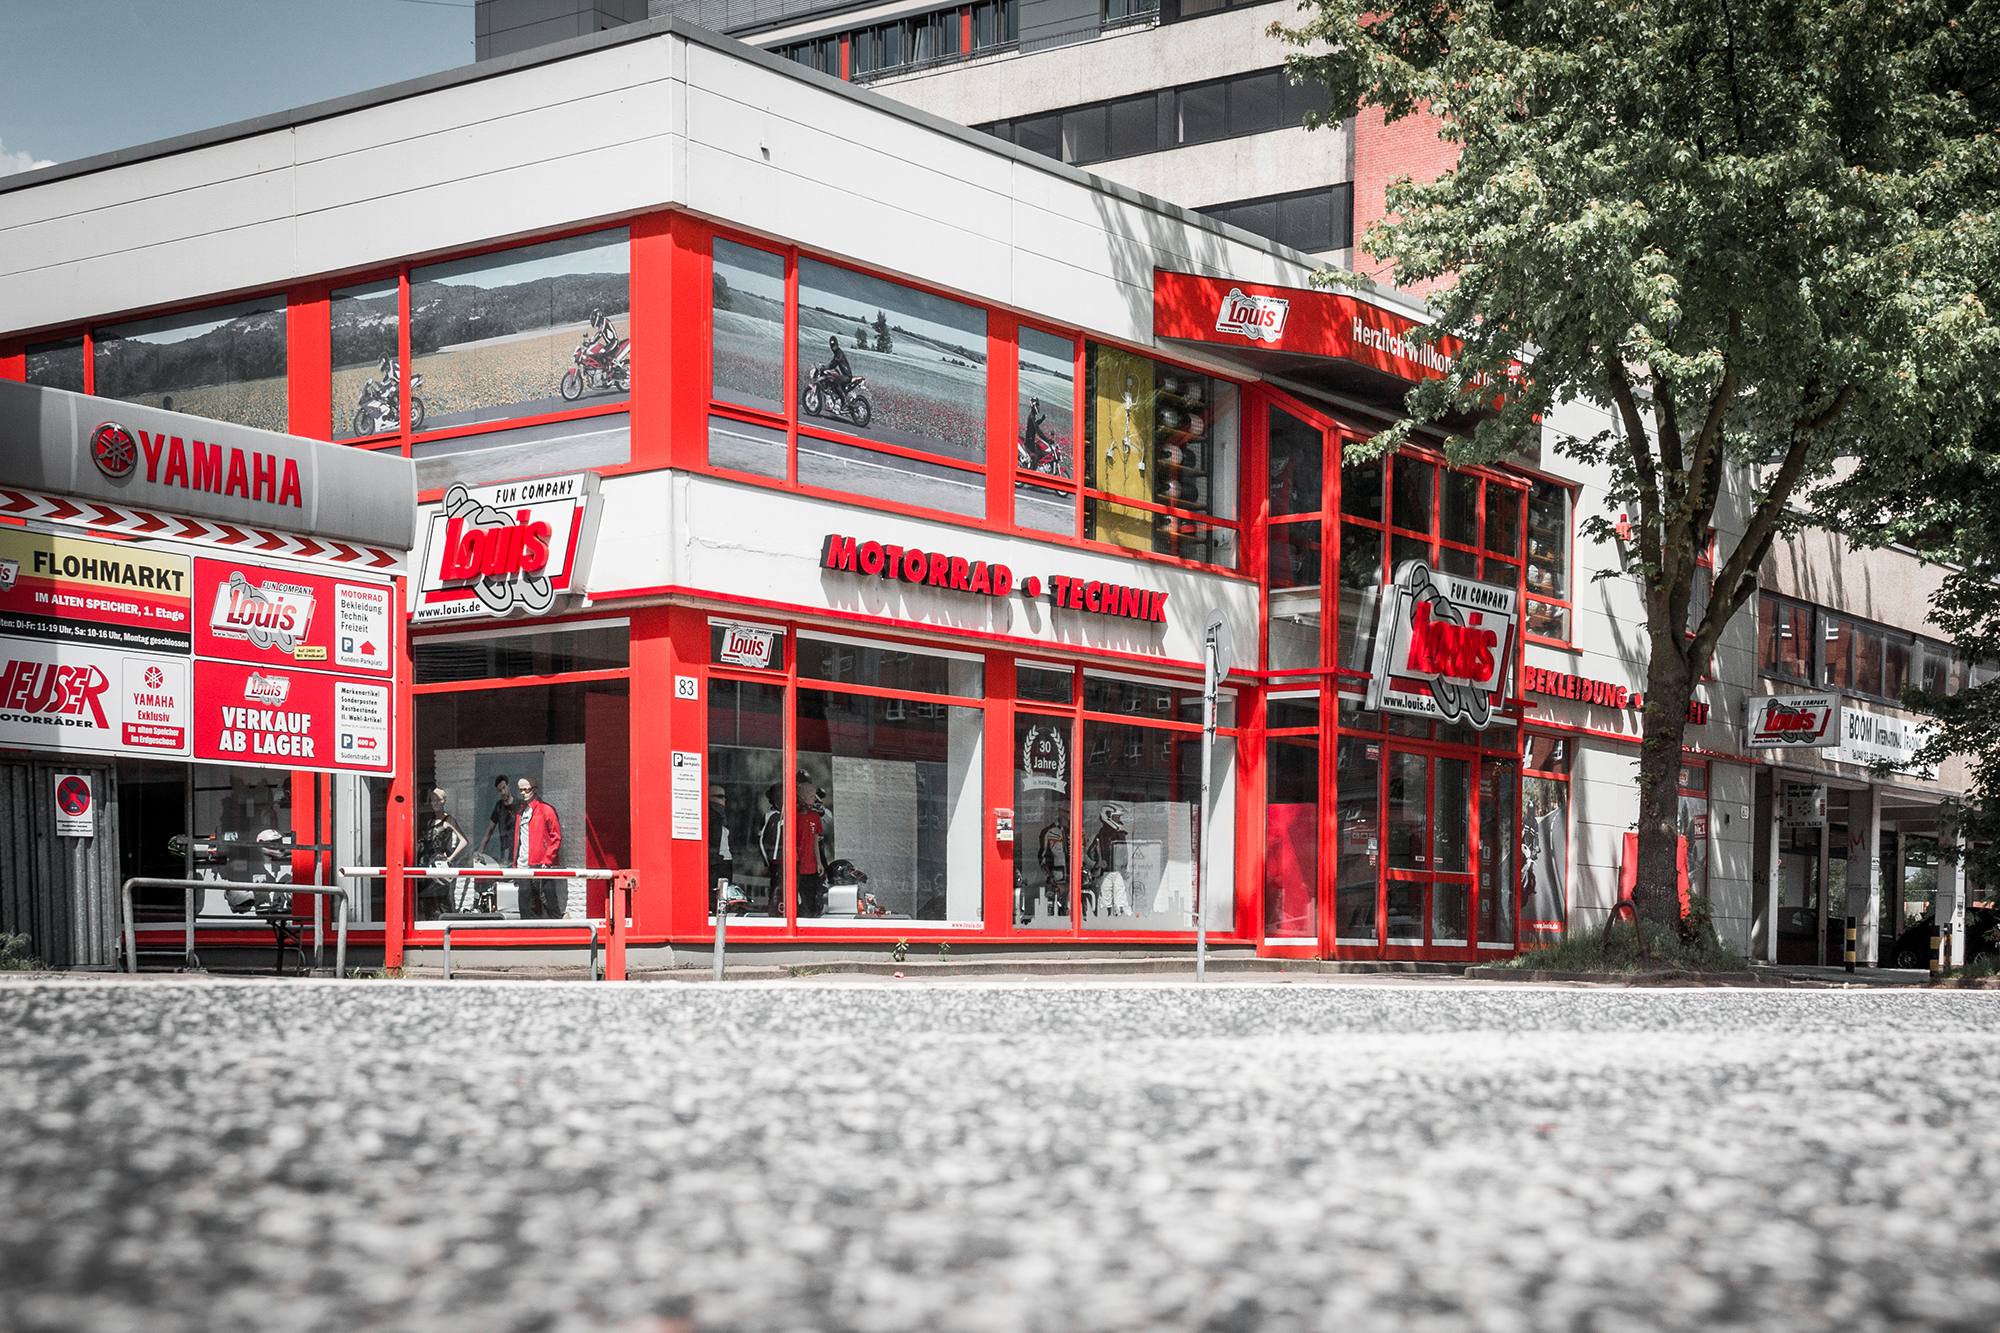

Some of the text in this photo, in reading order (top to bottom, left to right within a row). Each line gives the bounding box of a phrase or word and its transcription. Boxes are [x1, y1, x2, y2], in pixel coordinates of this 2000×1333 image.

[1228, 300, 1276, 327] Louis
[1353, 316, 1405, 358] Herzlich
[138, 430, 302, 508] YAMAHA
[496, 480, 574, 503] FUN COMPANY
[439, 509, 552, 584] Louis
[34, 550, 184, 592] FLOHMARKT
[821, 533, 1170, 623] MOTORRAD TECHNIK
[262, 581, 313, 597] FUN COMPANY
[341, 589, 383, 603] MOTORRAD
[1450, 582, 1509, 610] FUN COMPANY
[35, 591, 185, 621] IM ALTEN SPEICHER, 1. Etage
[227, 589, 297, 631] Louis
[341, 600, 383, 615] Bekleidung
[341, 610, 369, 622] Technik
[418, 602, 481, 618] www.louis.de
[16, 620, 36, 631] Di-Fr:
[37, 622, 58, 632] 11-19
[59, 625, 74, 636] Uhr,
[75, 626, 87, 636] Sa:
[109, 631, 123, 642] Uhr,
[123, 633, 150, 645] Montag
[150, 635, 190, 648] geschlossen
[341, 622, 369, 633] Freizeit
[729, 632, 764, 657] Louis
[1407, 600, 1498, 682] Louis
[251, 679, 282, 697] Louis
[341, 687, 380, 697] Markenartikel
[678, 679, 694, 696] 83
[1525, 666, 1628, 709] BEKLEIDUNG
[133, 692, 175, 708] YAMAHA
[1384, 695, 1436, 713] www.louis.de
[0, 713, 94, 729] OTORRÄDER
[138, 710, 170, 722] Exklusiv
[221, 706, 312, 734] VERKAUF
[1764, 708, 1817, 732] Louis
[1849, 713, 1872, 742] BOOM
[218, 730, 315, 758] AB LAGER
[1039, 740, 1052, 753] 30
[1033, 756, 1057, 770] Jahre
